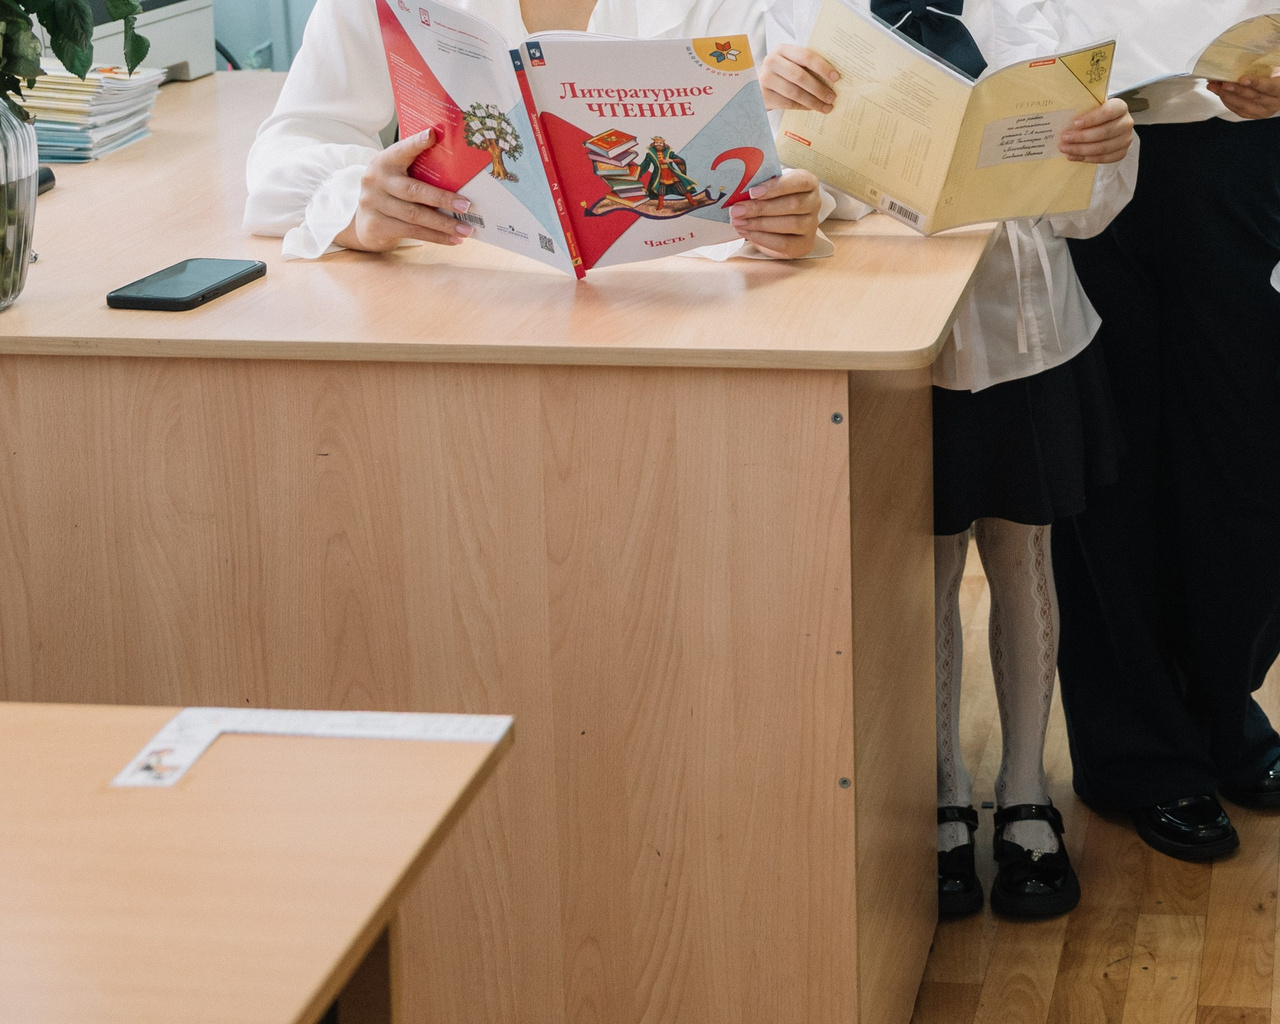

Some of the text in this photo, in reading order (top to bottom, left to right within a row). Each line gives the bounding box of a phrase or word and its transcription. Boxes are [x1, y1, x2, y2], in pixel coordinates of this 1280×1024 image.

[559, 81, 715, 102] Литературное
[586, 101, 695, 118] ЧТЕНИЕ
[710, 146, 765, 209] 2
[643, 236, 686, 248] Часть
